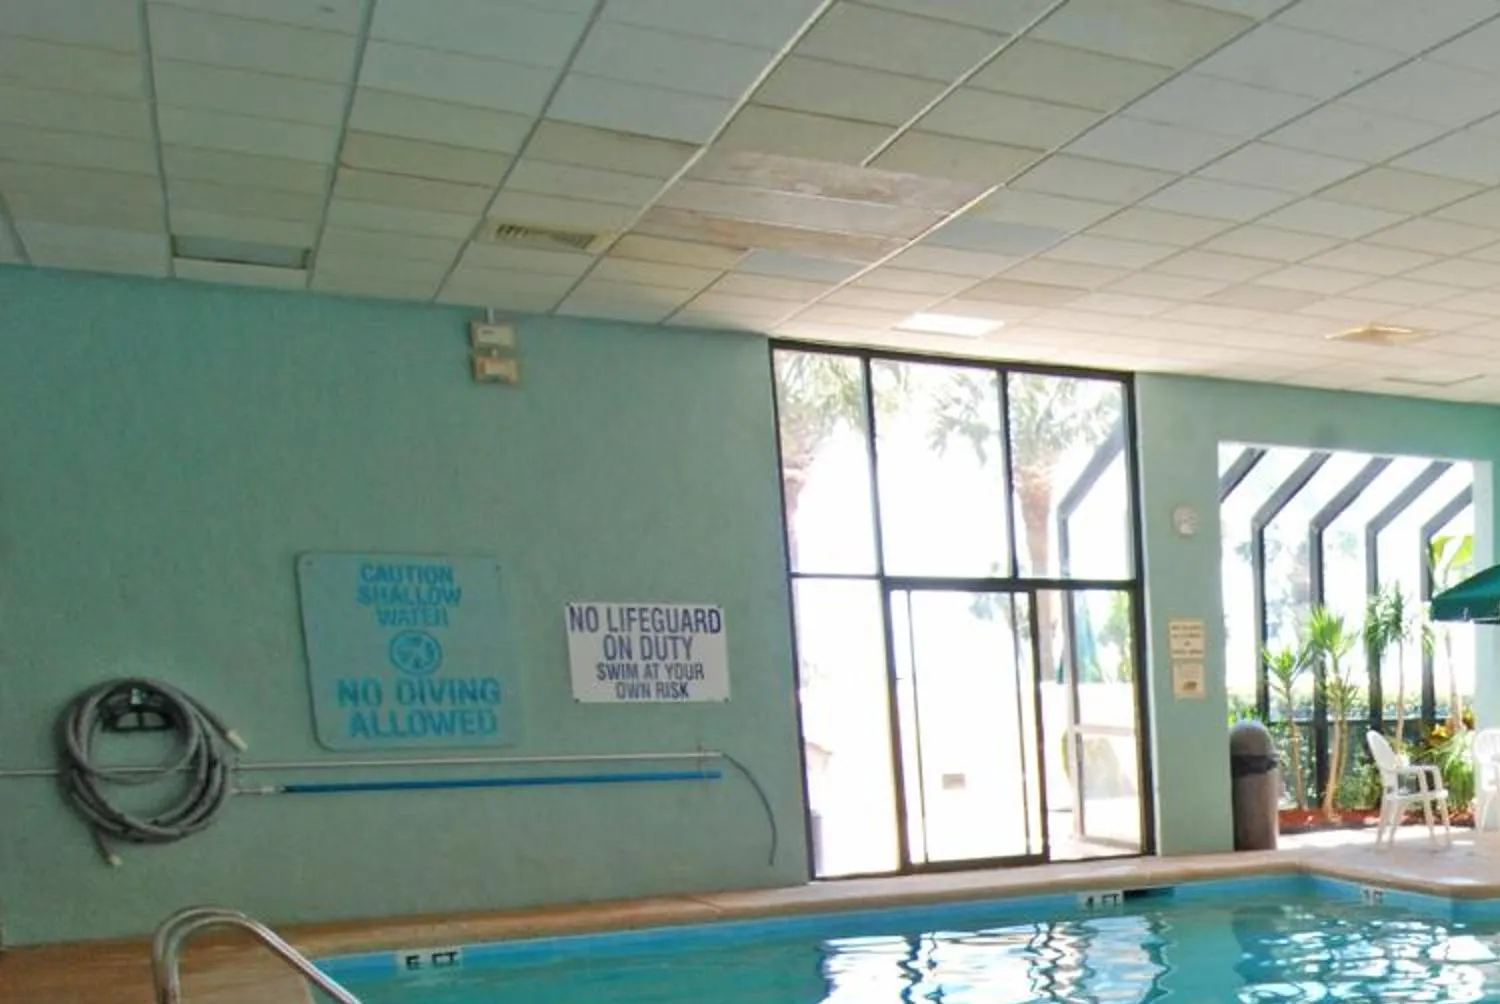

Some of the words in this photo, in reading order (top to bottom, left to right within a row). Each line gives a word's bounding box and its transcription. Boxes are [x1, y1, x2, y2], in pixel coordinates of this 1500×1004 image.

[360, 563, 455, 584] CAUTION
[356, 585, 463, 607] SHALLOW
[376, 606, 449, 628] WATER
[569, 605, 599, 633] NO
[606, 606, 721, 634] LIFEGUARD
[603, 634, 633, 661] ON
[640, 635, 693, 661] DUTY
[596, 662, 638, 681] SWIM
[643, 663, 660, 680] AT
[664, 663, 705, 680] YOUR
[337, 678, 383, 707] NO
[396, 676, 502, 706] DIVING
[615, 681, 650, 699] OWN
[655, 681, 689, 699] RISK
[351, 708, 499, 739] ALLOWED
